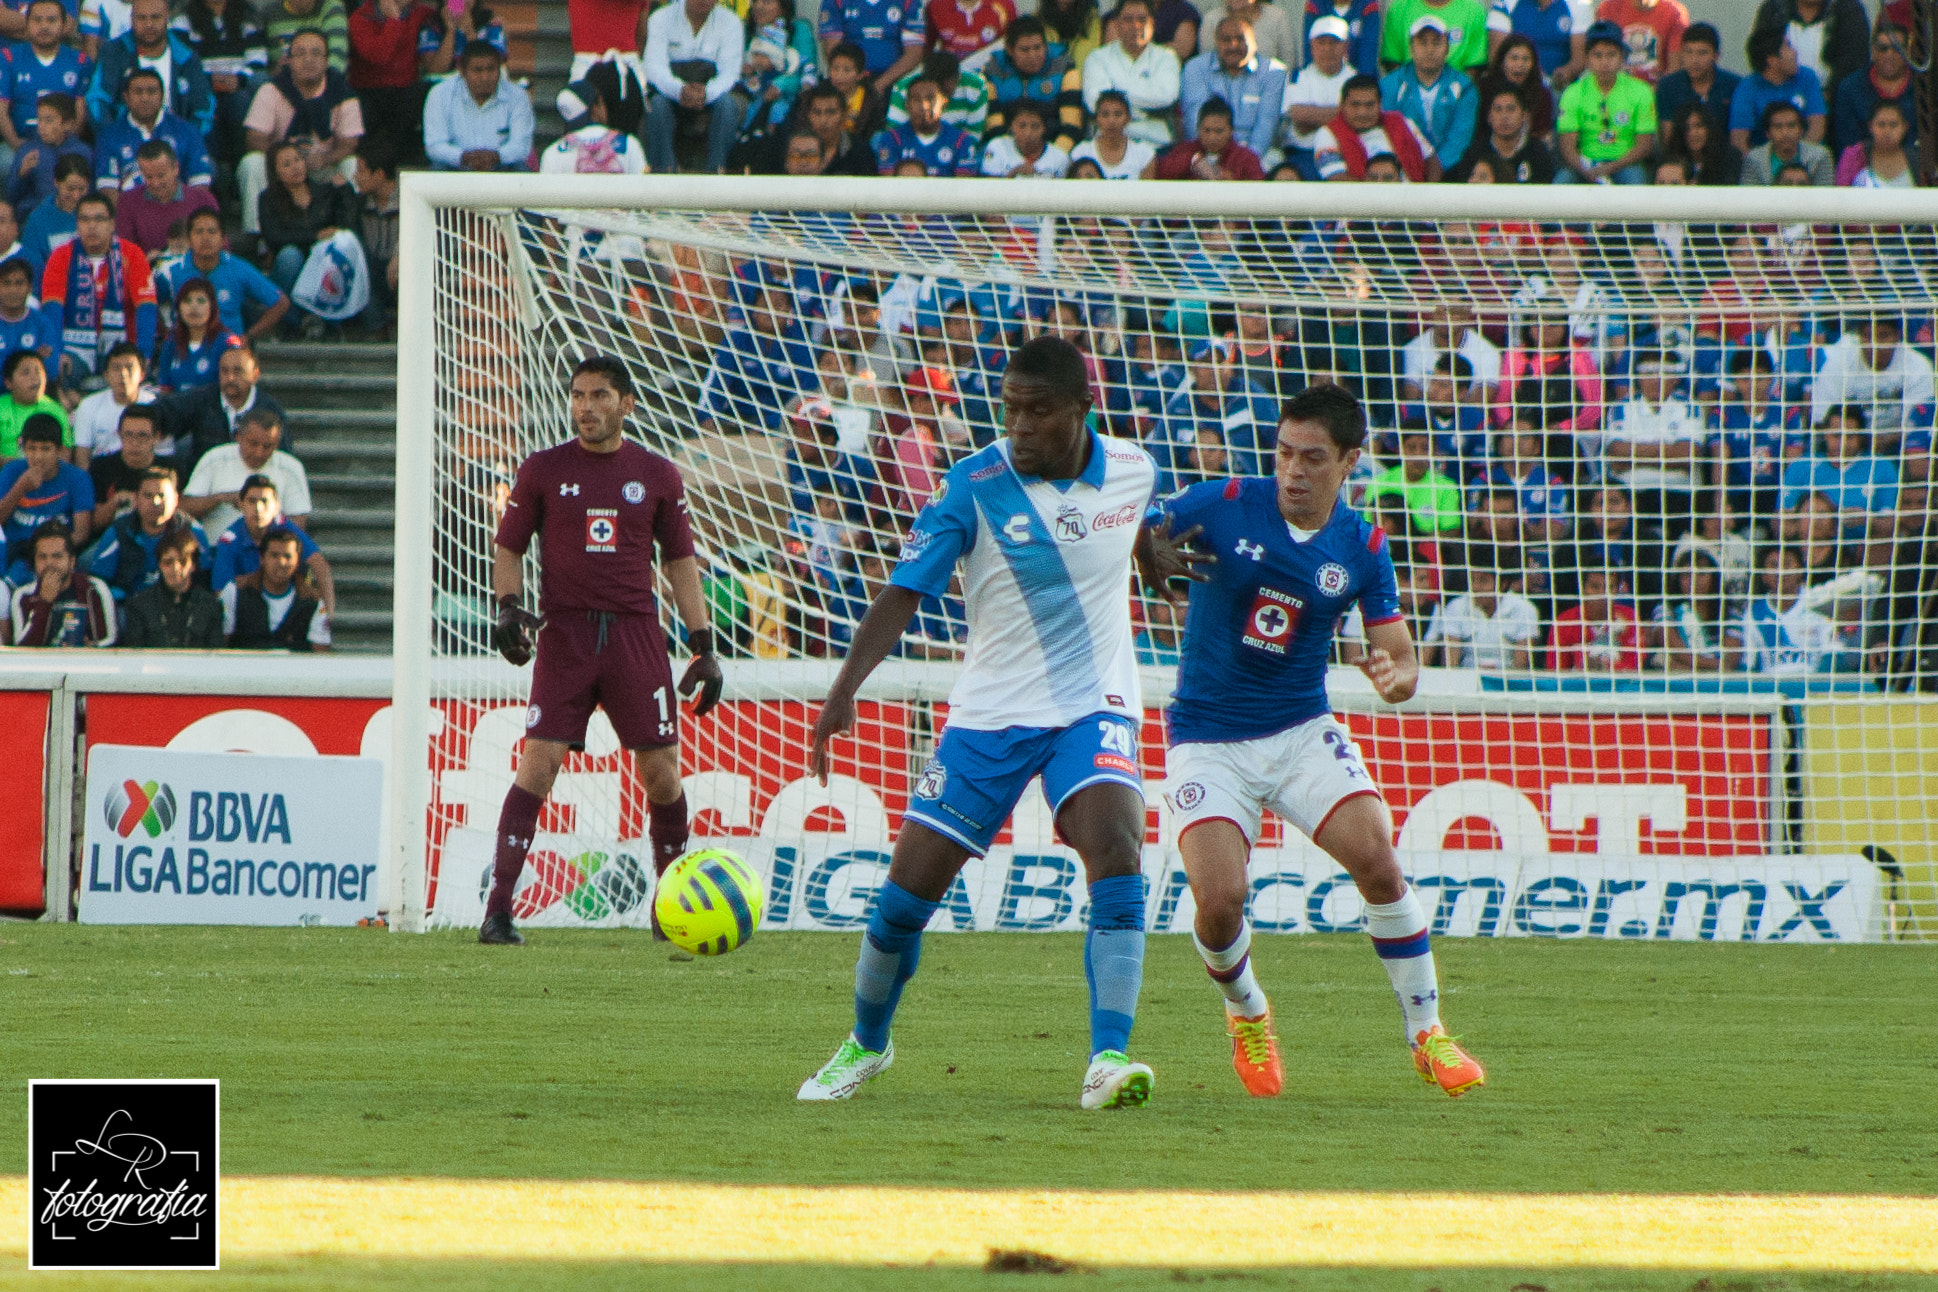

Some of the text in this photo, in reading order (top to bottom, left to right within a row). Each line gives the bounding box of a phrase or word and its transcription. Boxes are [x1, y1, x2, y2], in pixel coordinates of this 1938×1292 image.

[1105, 449, 1144, 462] Somos
[1258, 586, 1304, 609] CEMENTO
[1242, 634, 1286, 655] CRUZ AZUL
[653, 686, 668, 721] 1
[1098, 720, 1130, 757] 29
[188, 791, 292, 845] BBVA
[89, 843, 377, 902] LIGA Bancomer
[766, 846, 1851, 940] IGA Bcomer.mx
